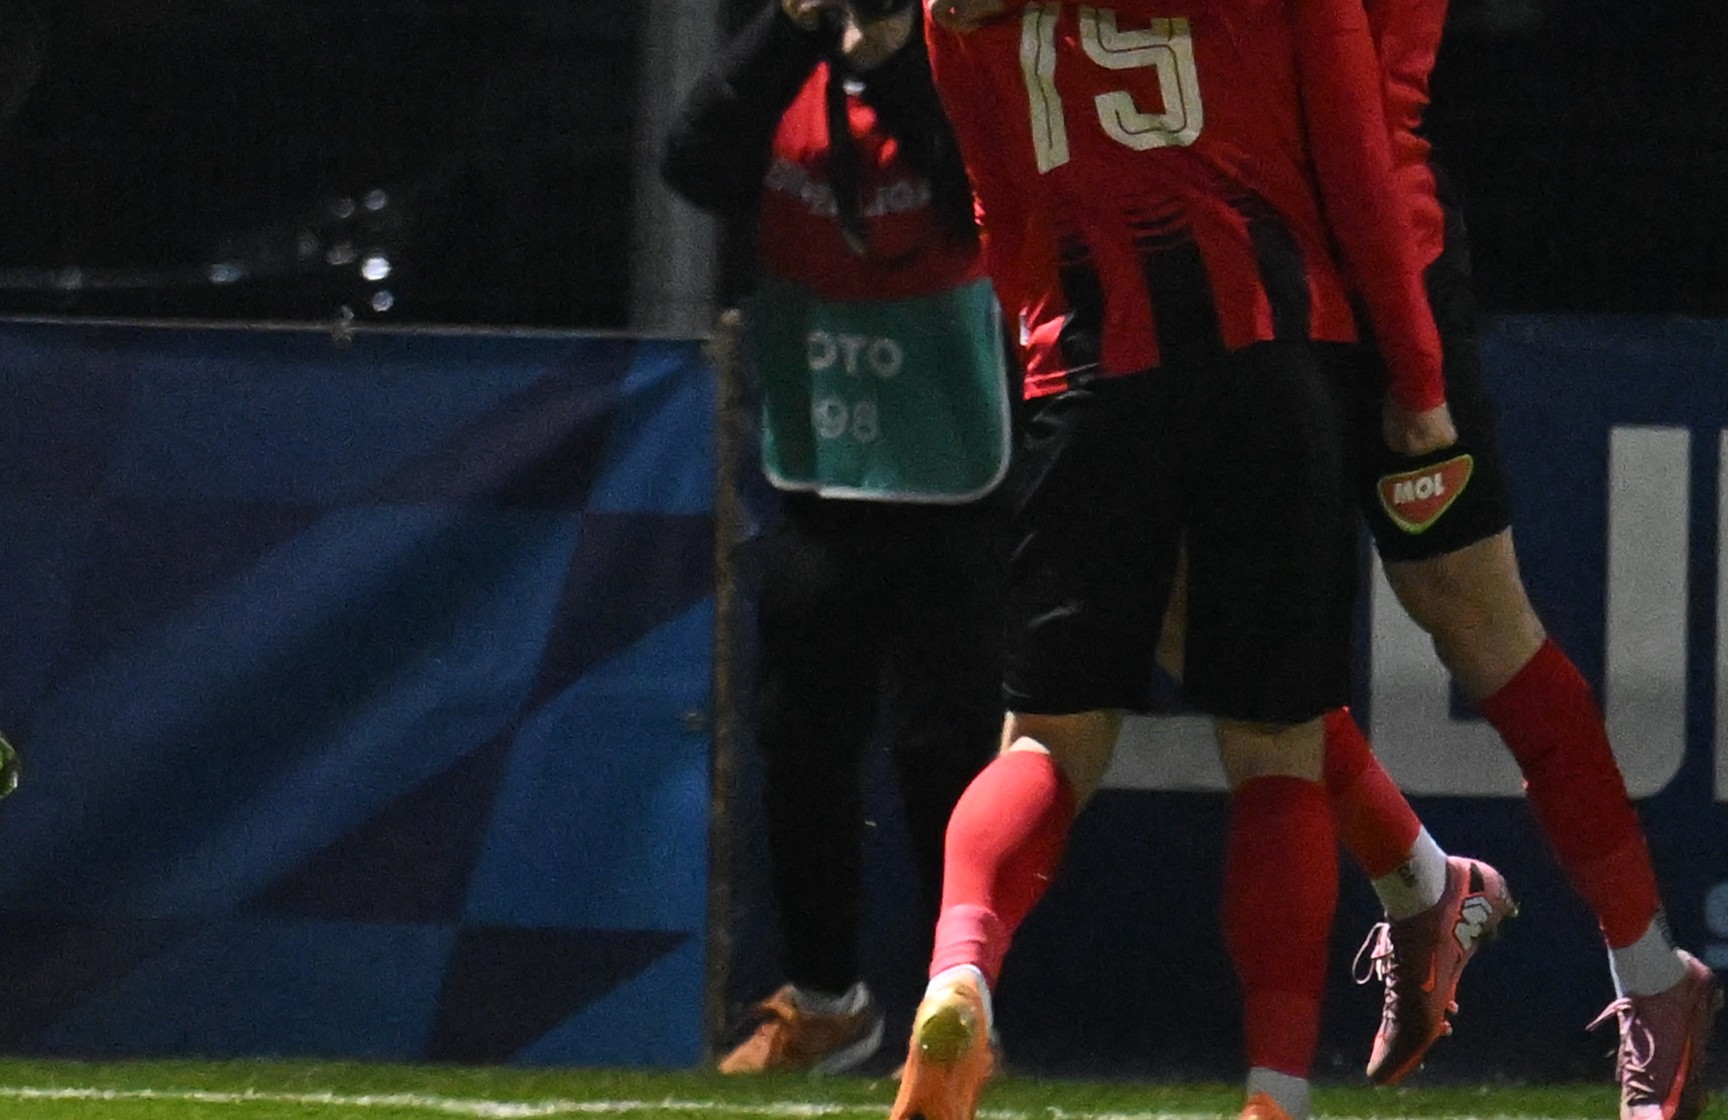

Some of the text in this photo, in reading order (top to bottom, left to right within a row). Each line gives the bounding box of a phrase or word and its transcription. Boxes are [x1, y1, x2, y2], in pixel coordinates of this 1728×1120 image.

[1020, 1, 1203, 174] 19
[805, 330, 903, 378] OTO
[1393, 472, 1446, 505] MOL
